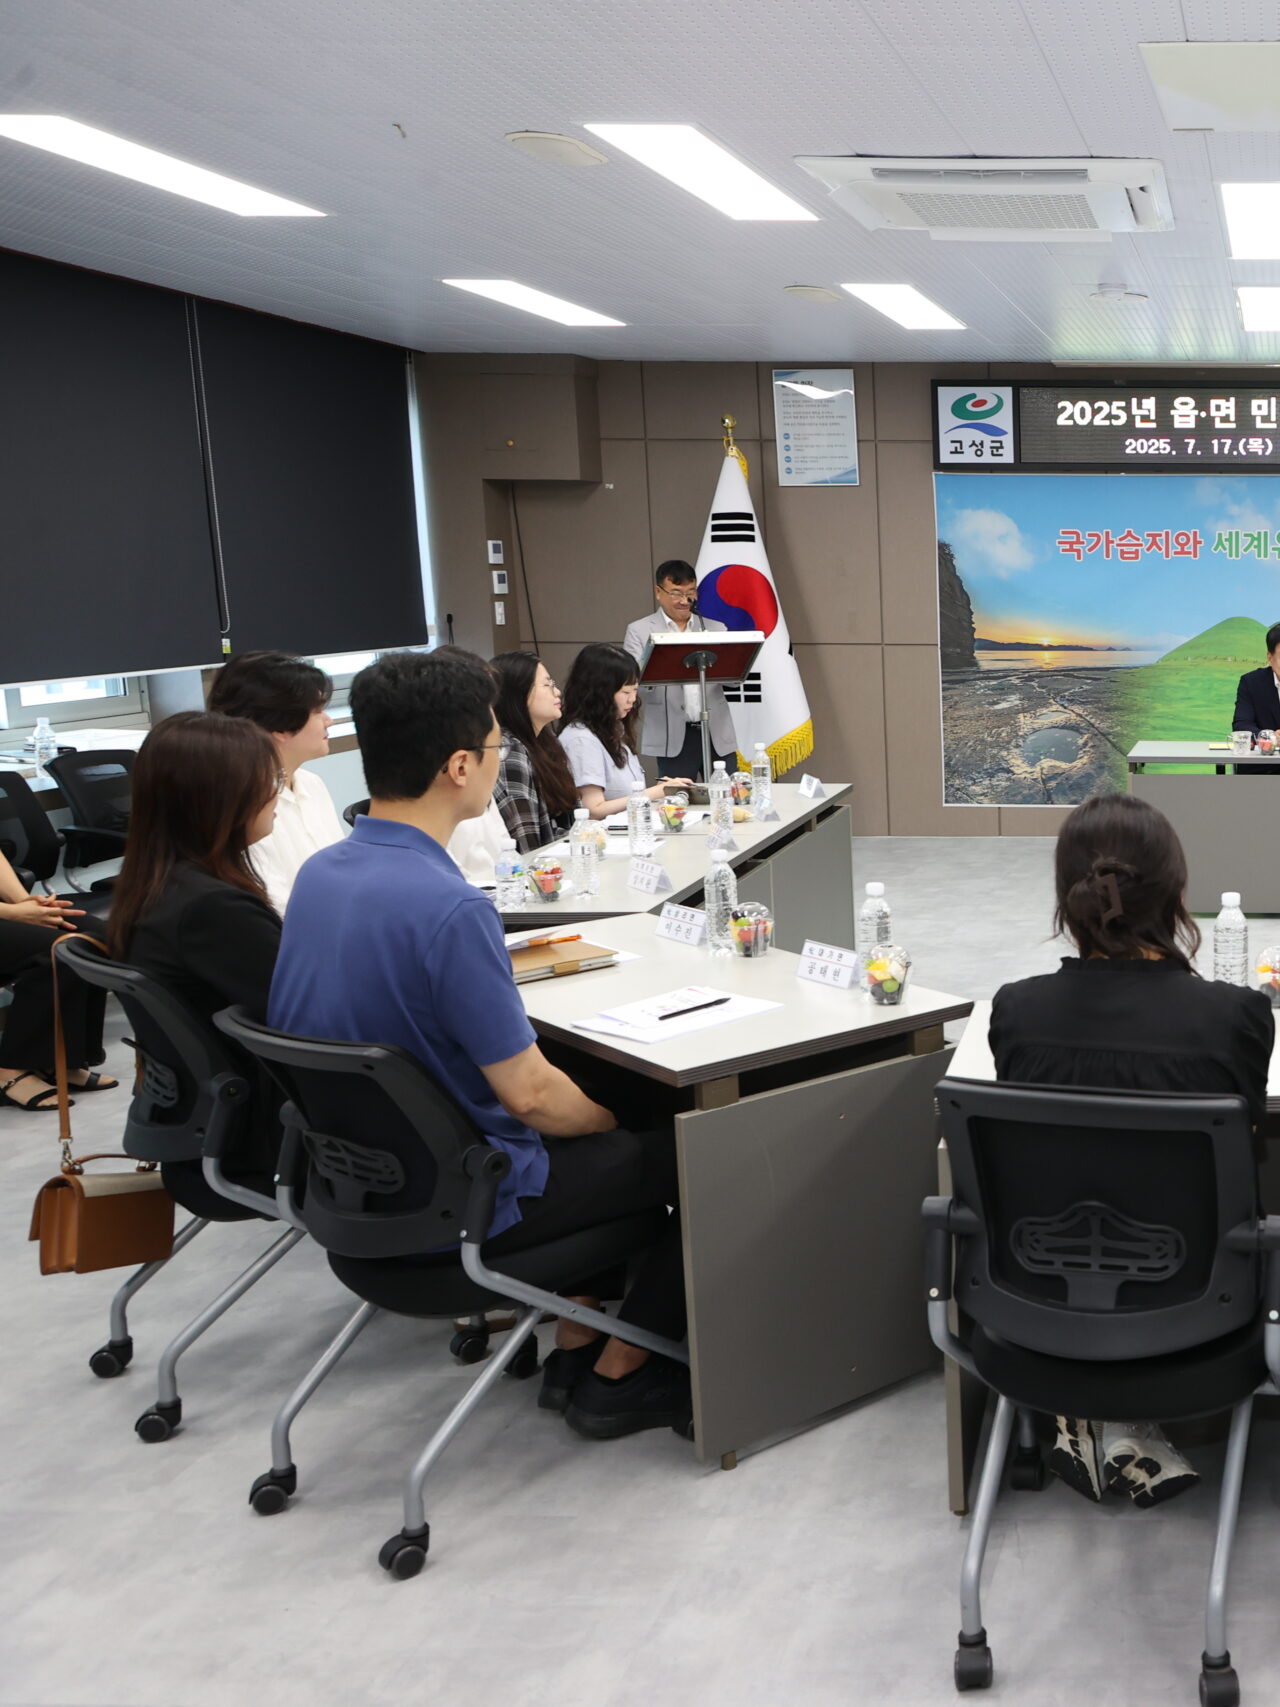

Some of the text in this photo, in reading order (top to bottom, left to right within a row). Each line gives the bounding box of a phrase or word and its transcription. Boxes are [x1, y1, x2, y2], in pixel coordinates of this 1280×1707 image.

[1056, 396, 1157, 428] 2025년
[1170, 396, 1237, 428] 읍·면
[949, 440, 1004, 458] 고성군
[1125, 438, 1177, 455] 2025.
[1184, 438, 1202, 455] 7.
[1211, 437, 1273, 456] 17.(목)
[1056, 529, 1203, 561] 국가습지와
